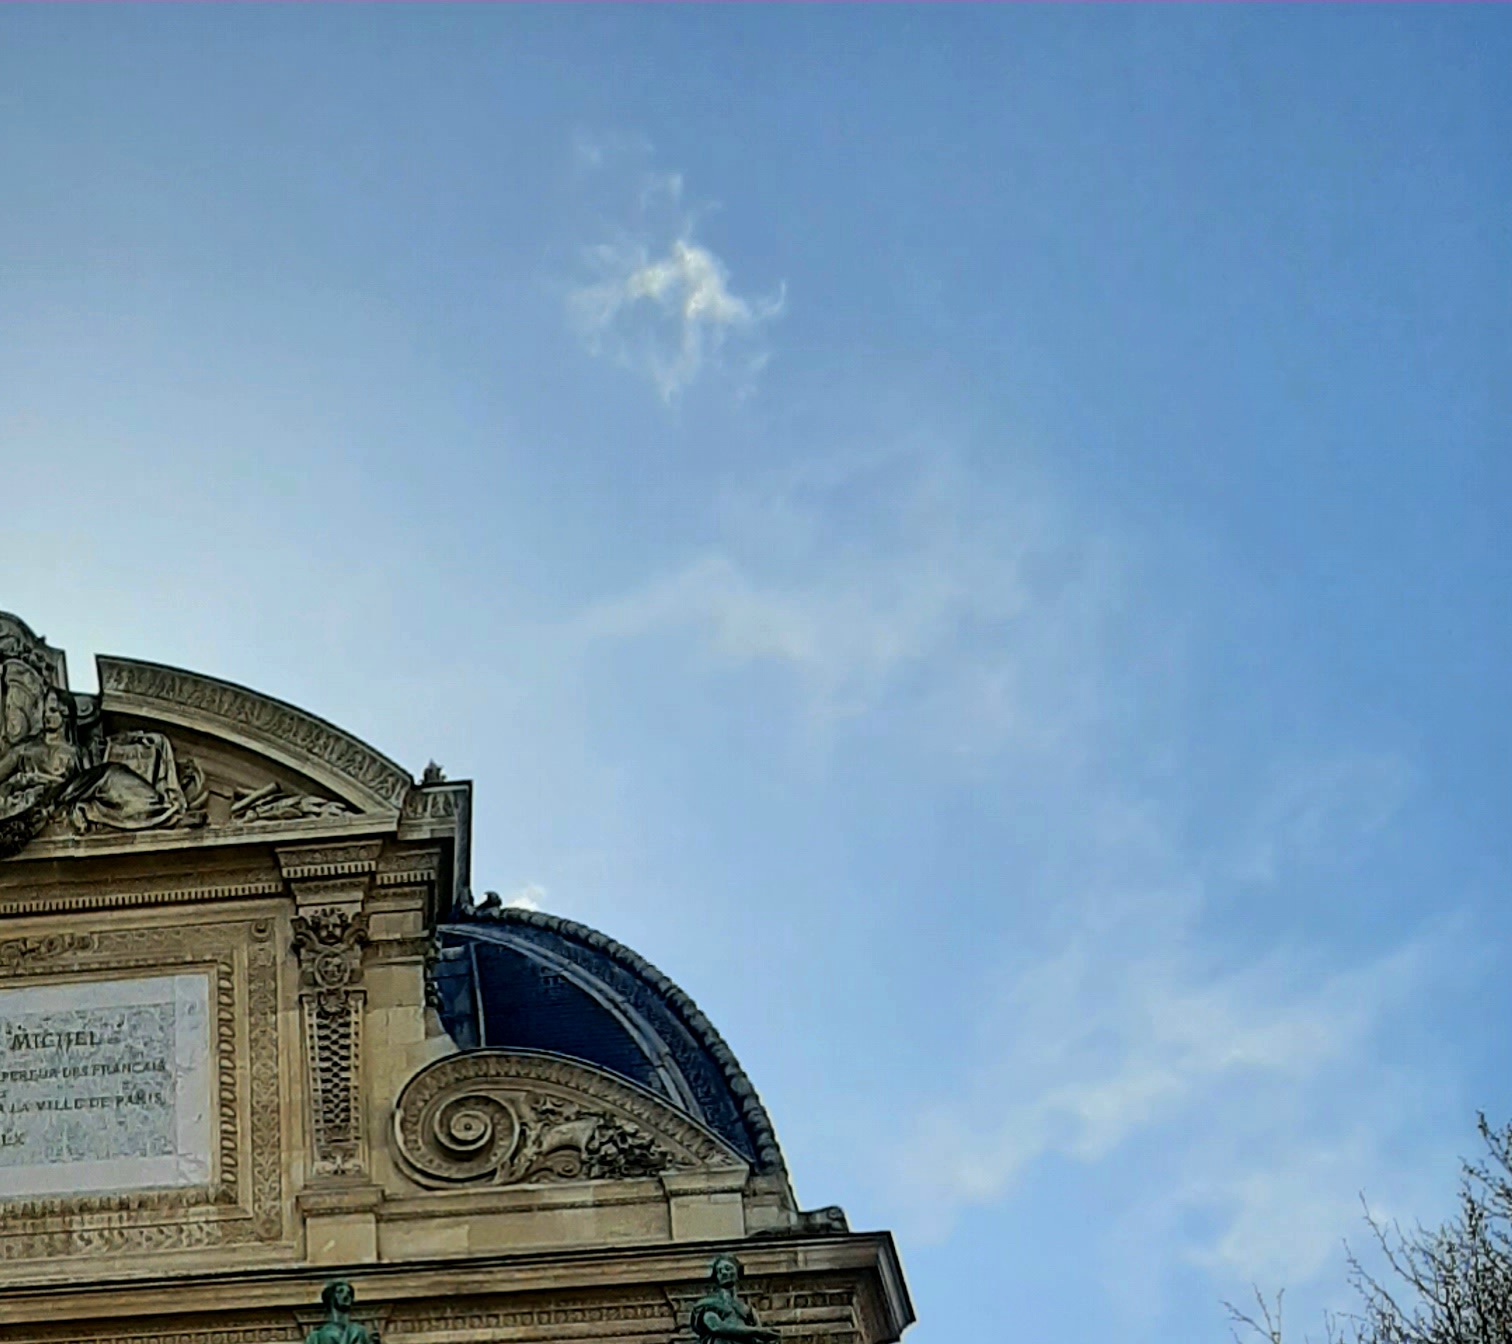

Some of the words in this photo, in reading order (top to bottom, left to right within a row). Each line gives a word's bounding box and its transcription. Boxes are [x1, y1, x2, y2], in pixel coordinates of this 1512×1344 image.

[10, 1030, 101, 1051] MICHEL
[9, 1102, 30, 1114] LA
[36, 1097, 85, 1111] VILLE
[88, 1096, 110, 1109] DE
